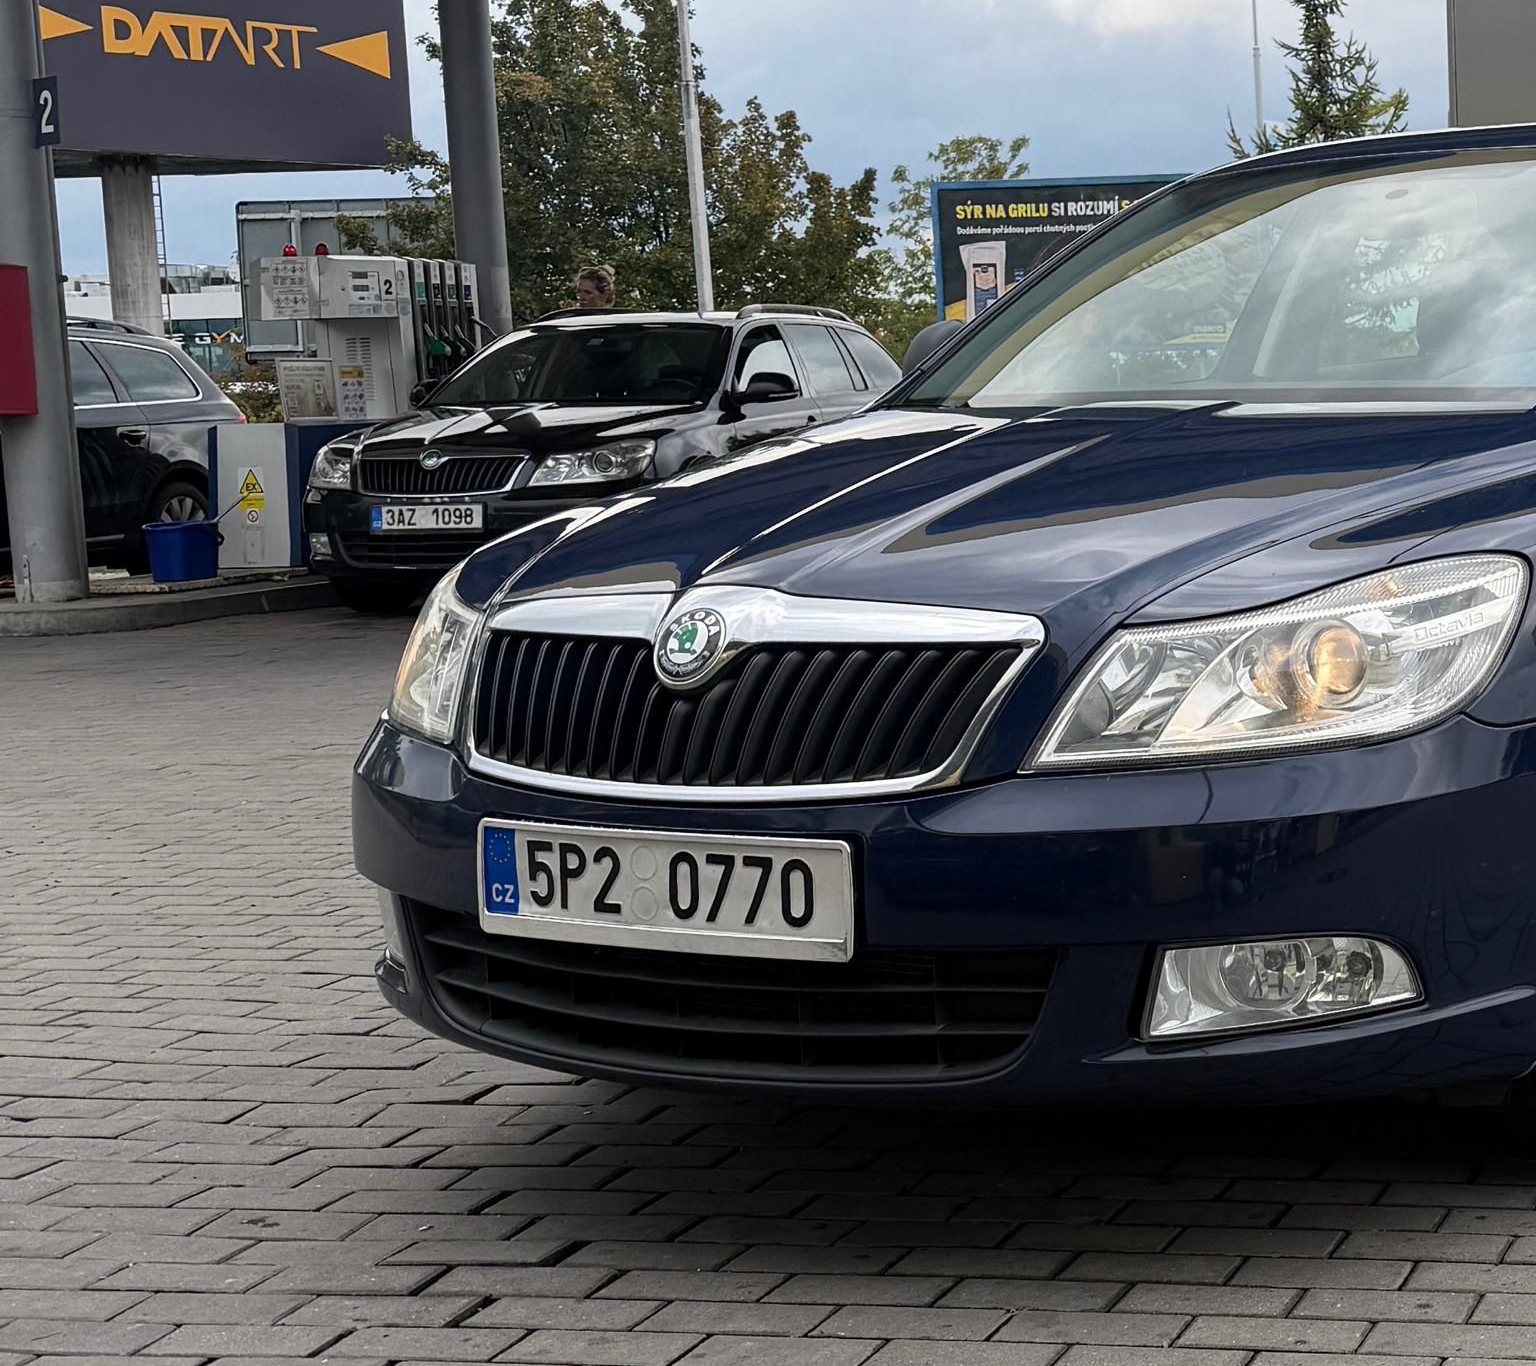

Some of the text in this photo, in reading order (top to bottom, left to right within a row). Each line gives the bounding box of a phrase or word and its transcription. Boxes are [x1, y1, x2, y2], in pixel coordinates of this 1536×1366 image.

[101, 5, 318, 69] DATART
[39, 89, 55, 134] 2
[955, 199, 984, 219] SÝR
[985, 204, 1006, 219] NA
[1008, 202, 1049, 218] GRILU
[1051, 202, 1065, 216] SI
[1067, 195, 1119, 216] ROZUMÍ
[956, 226, 991, 235] Dodáváme
[992, 224, 1025, 236] pořádnou
[383, 278, 394, 296] 2
[245, 482, 257, 492] EX
[386, 507, 474, 527] 3AZ 1098
[1413, 611, 1484, 642] Octavia
[492, 882, 515, 904] CZ
[526, 839, 814, 928] 5P2 0770
